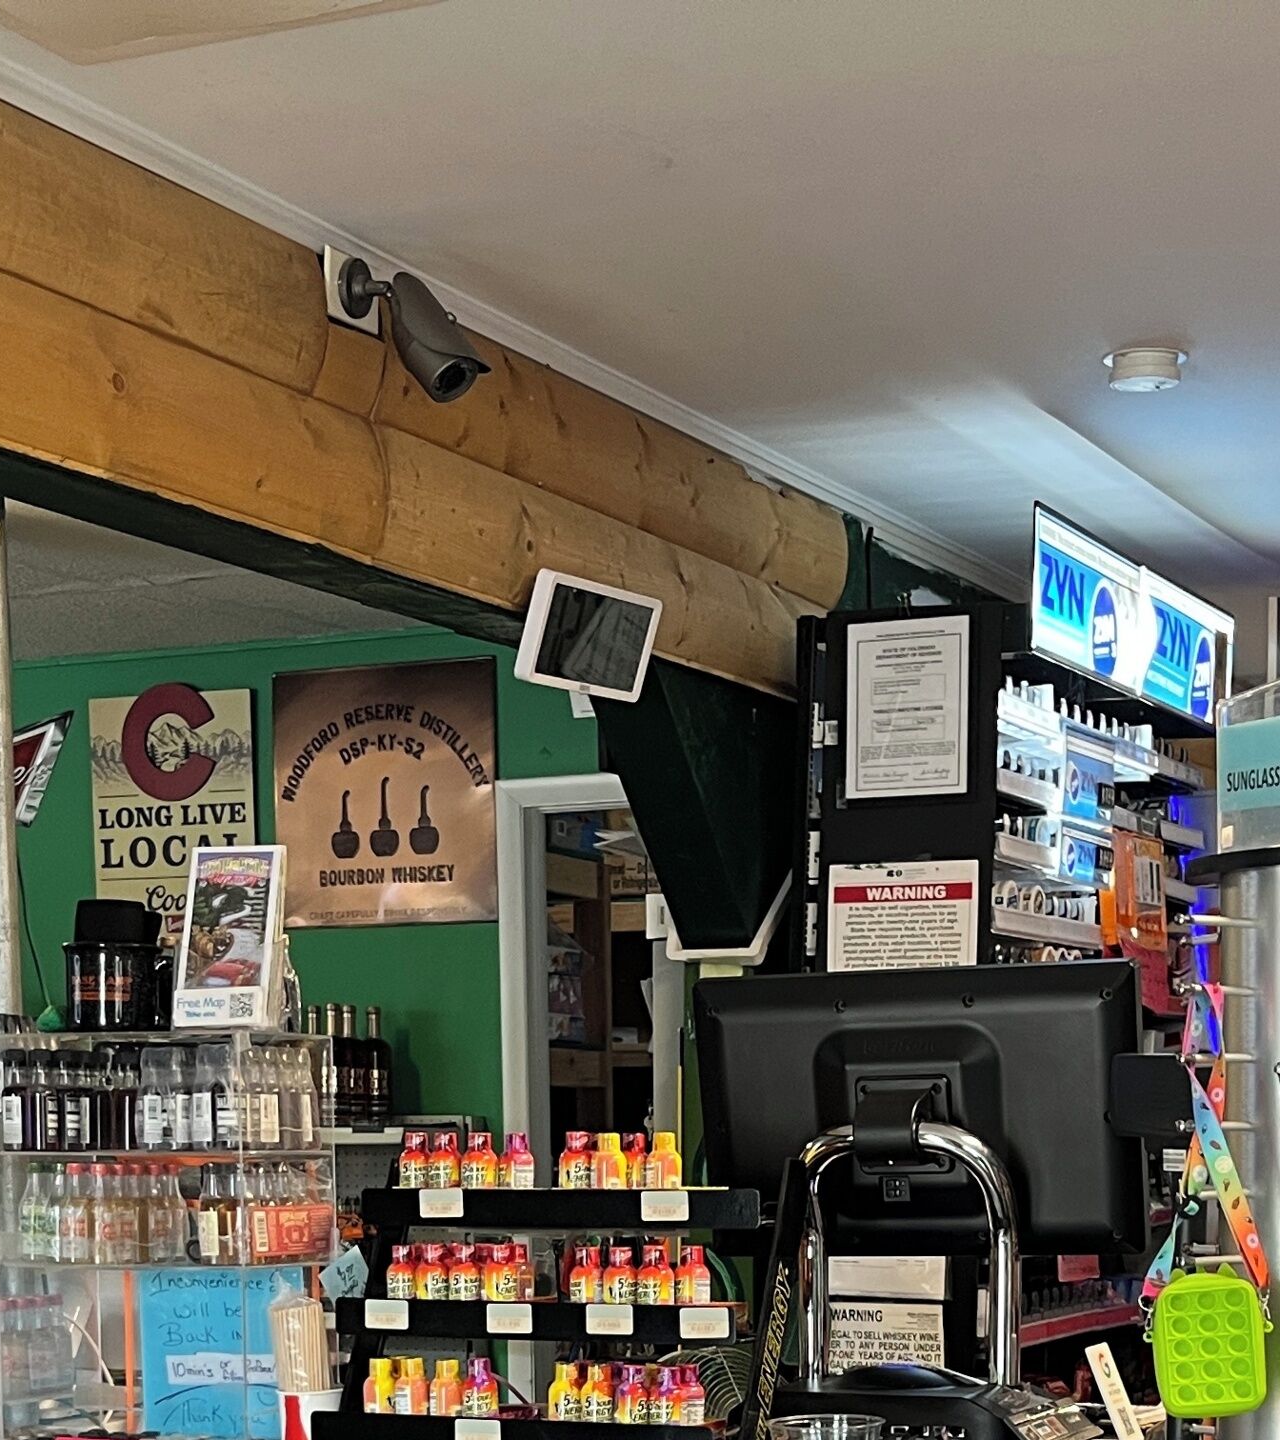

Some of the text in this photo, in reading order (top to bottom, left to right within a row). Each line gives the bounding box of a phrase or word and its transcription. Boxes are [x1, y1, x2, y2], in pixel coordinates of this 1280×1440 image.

[1041, 551, 1085, 626] ZYN
[1156, 609, 1190, 673] ZYN
[281, 703, 490, 802] WOODFORD RESERVE DISTILLERY
[99, 803, 247, 830] LONG LIVE
[320, 864, 455, 887] BOURBON WHISKEY
[866, 885, 947, 901] WARNING
[176, 998, 226, 1010] Free Map
[174, 1302, 210, 1319] Will
[831, 1309, 883, 1322] WARNING
[758, 1261, 791, 1411] ENERGY
[853, 1330, 862, 1339] TO
[864, 1331, 880, 1340] SELL
[882, 1332, 917, 1341] WHISKEY
[846, 1340, 941, 1352] TO ANY PERSON UNDER
[858, 1351, 883, 1360] YEARS
[885, 1352, 895, 1361] OF
